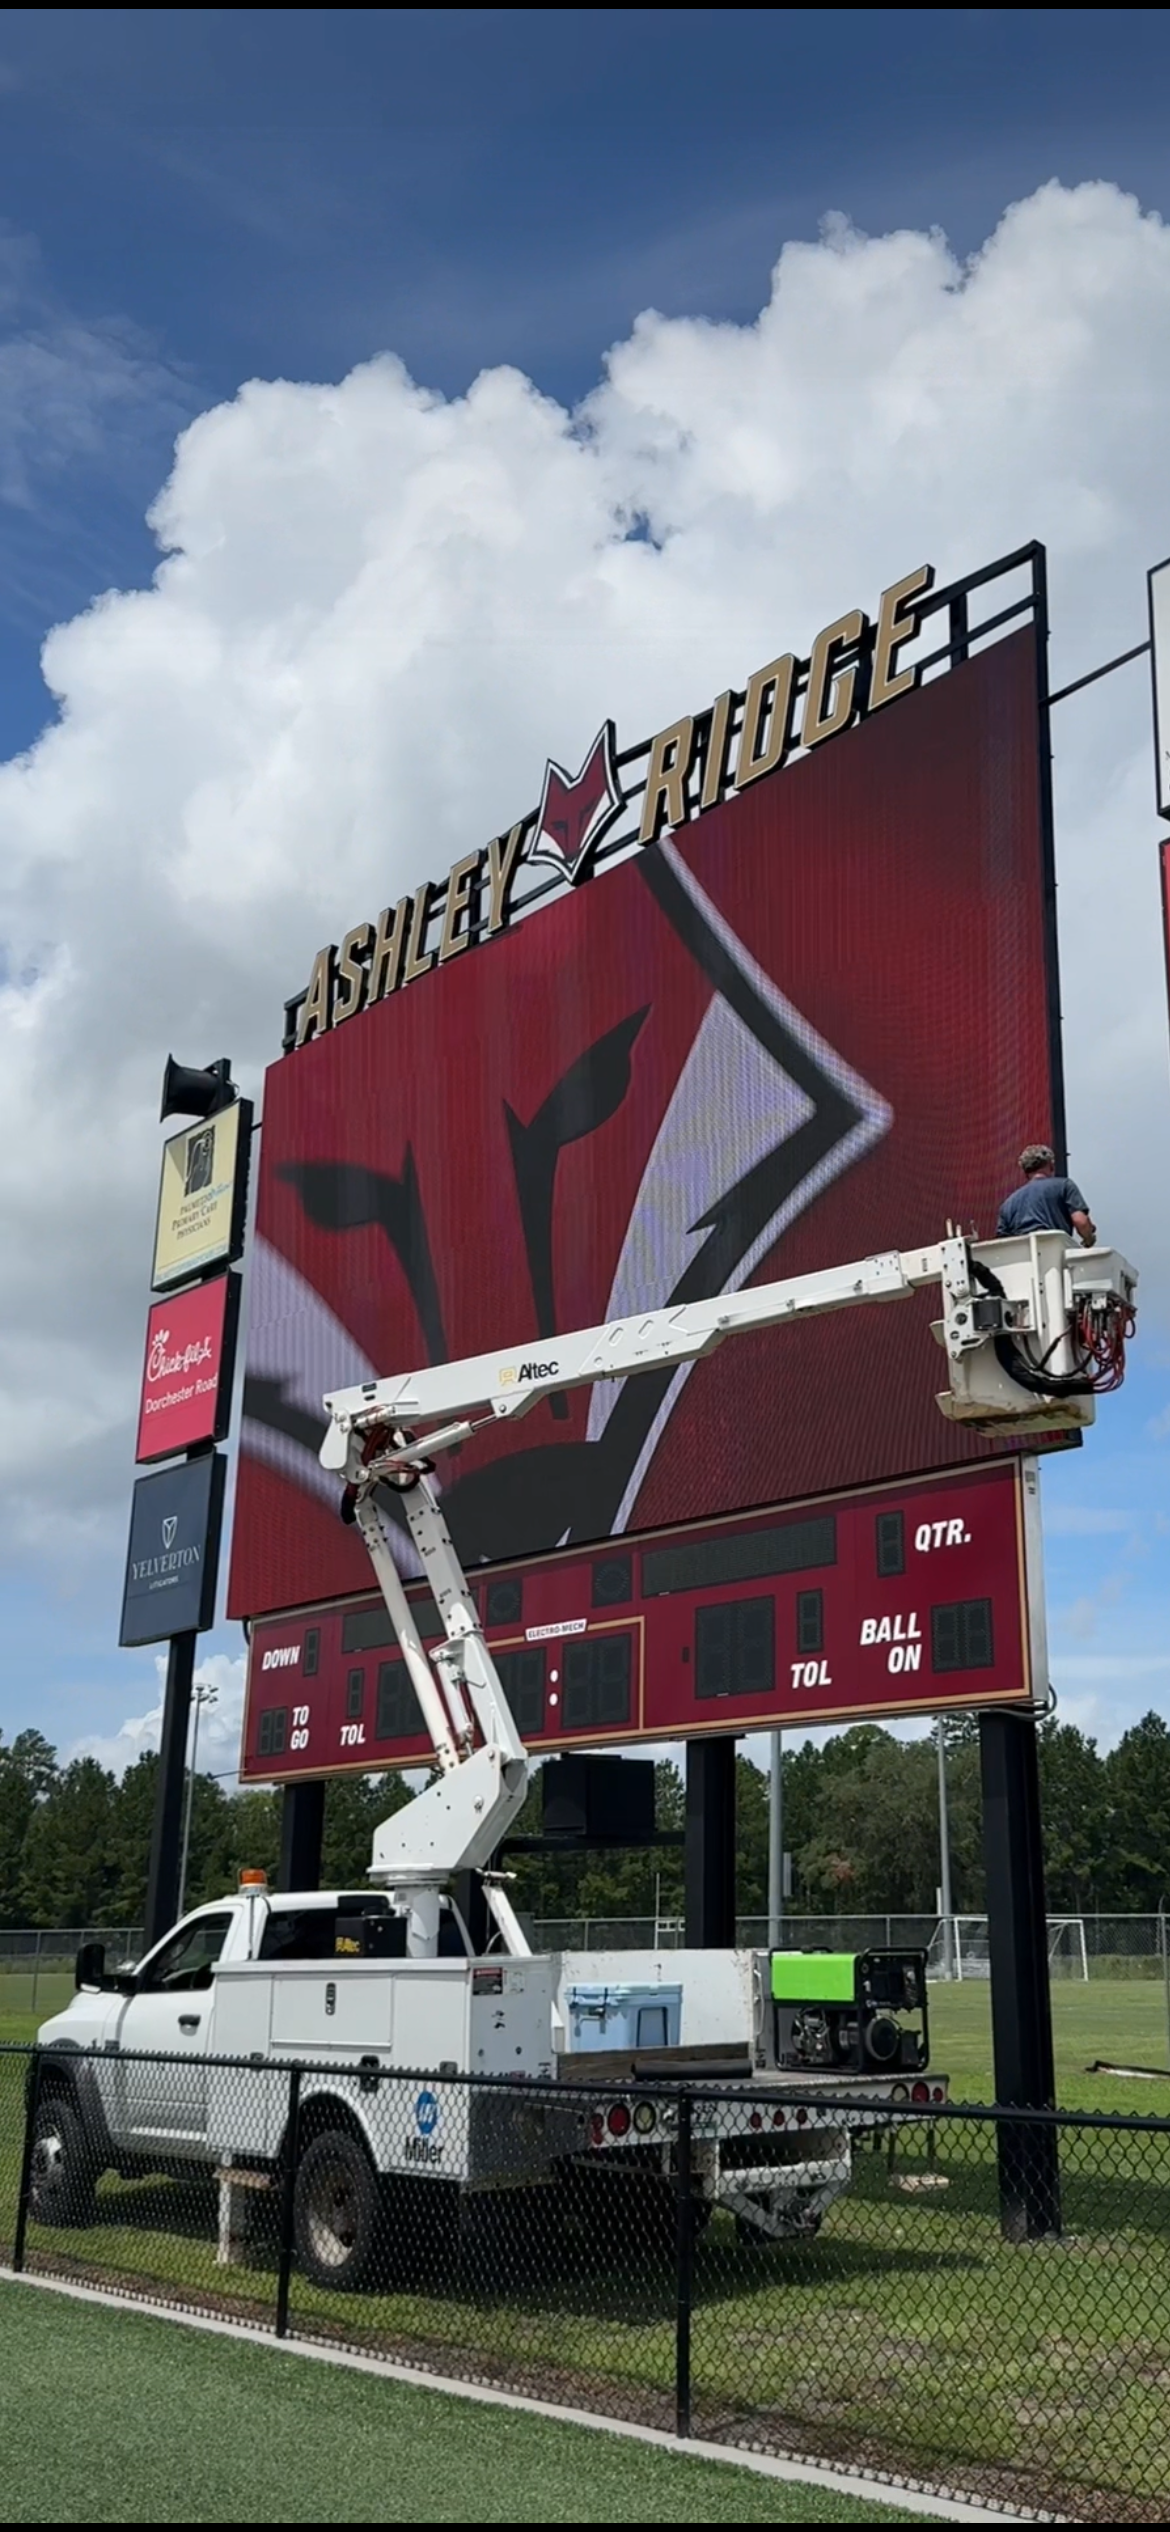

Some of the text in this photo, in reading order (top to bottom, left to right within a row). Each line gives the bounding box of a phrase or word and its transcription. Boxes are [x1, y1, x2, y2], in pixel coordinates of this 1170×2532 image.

[295, 563, 935, 1048] ASHLEY RIDGE
[147, 1330, 212, 1382] Chick-fil-A
[517, 1361, 559, 1383] Altec
[145, 1371, 218, 1415] Dorchester Road
[914, 1518, 972, 1552] QTR.
[132, 1544, 201, 1580] YELVERTON
[528, 1622, 585, 1639] ELECTRO-MECH
[860, 1612, 922, 1646] BALL
[261, 1645, 301, 1671] DOWN
[887, 1644, 922, 1674] ON
[790, 1660, 832, 1689] TOL
[292, 1705, 310, 1727] TO
[290, 1728, 310, 1750] GO
[340, 1723, 365, 1746] TOL
[405, 2134, 444, 2165] Miller
